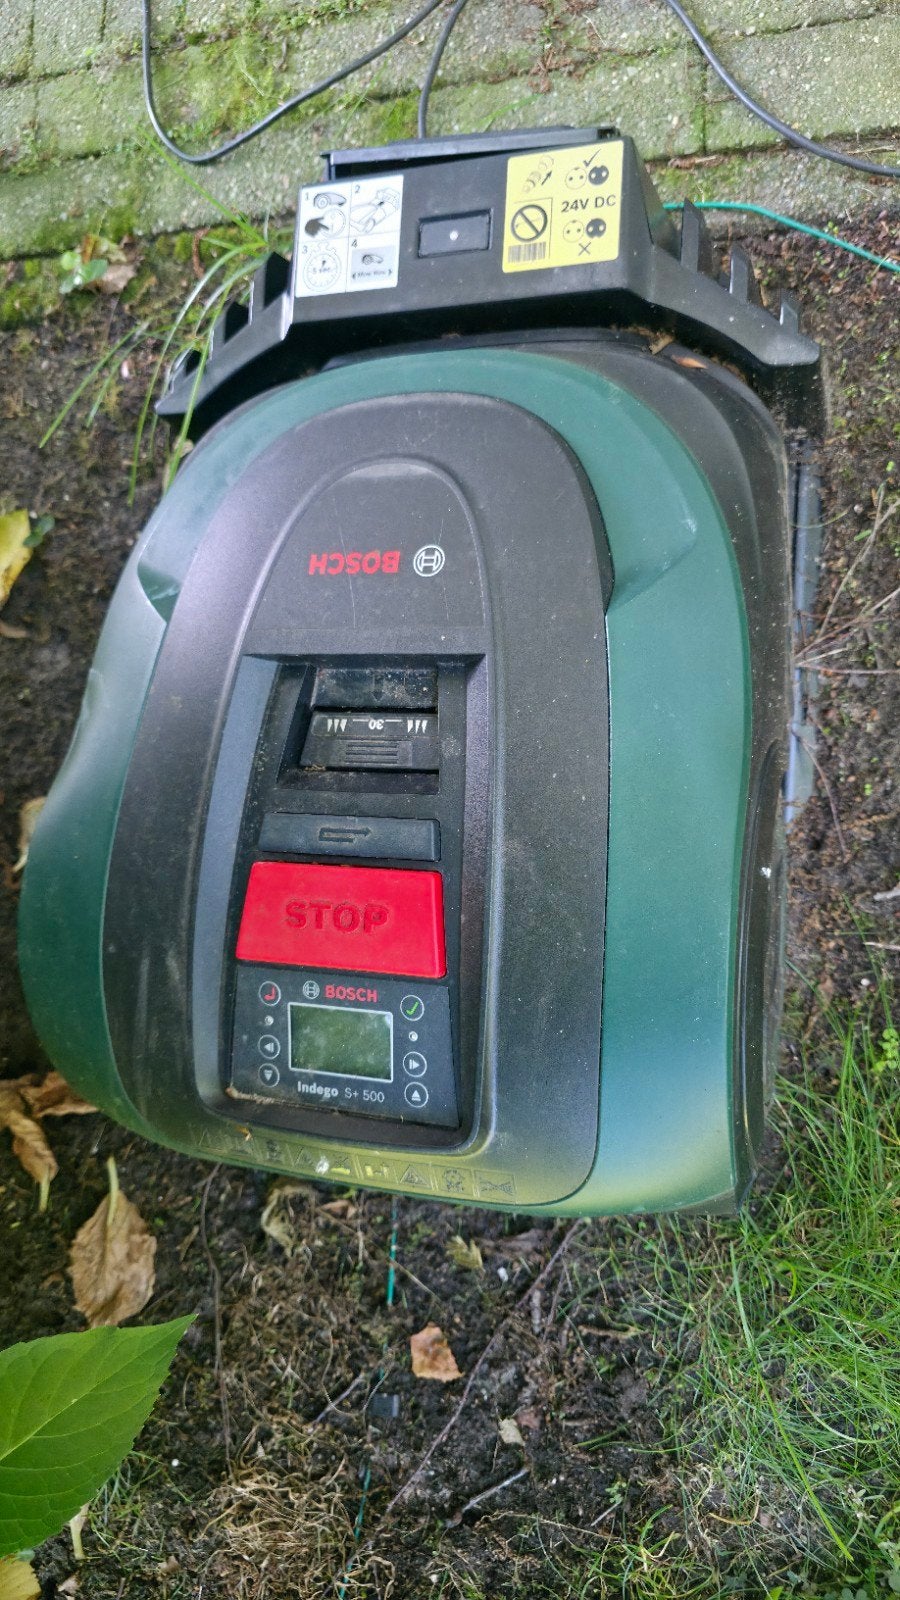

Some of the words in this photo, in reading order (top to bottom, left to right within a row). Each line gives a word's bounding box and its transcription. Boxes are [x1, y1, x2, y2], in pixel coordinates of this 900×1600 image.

[355, 184, 361, 194] 2
[561, 198, 589, 213] 24V
[594, 194, 616, 209] DC
[302, 245, 308, 254] 3
[351, 239, 358, 249] 4
[308, 551, 400, 575] BOSCH
[368, 719, 385, 730] 30
[285, 899, 389, 934] STOP
[325, 985, 378, 1002] BOSCH
[297, 1081, 339, 1098] Indego
[344, 1088, 359, 1099] S+
[363, 1090, 385, 1103] 500
